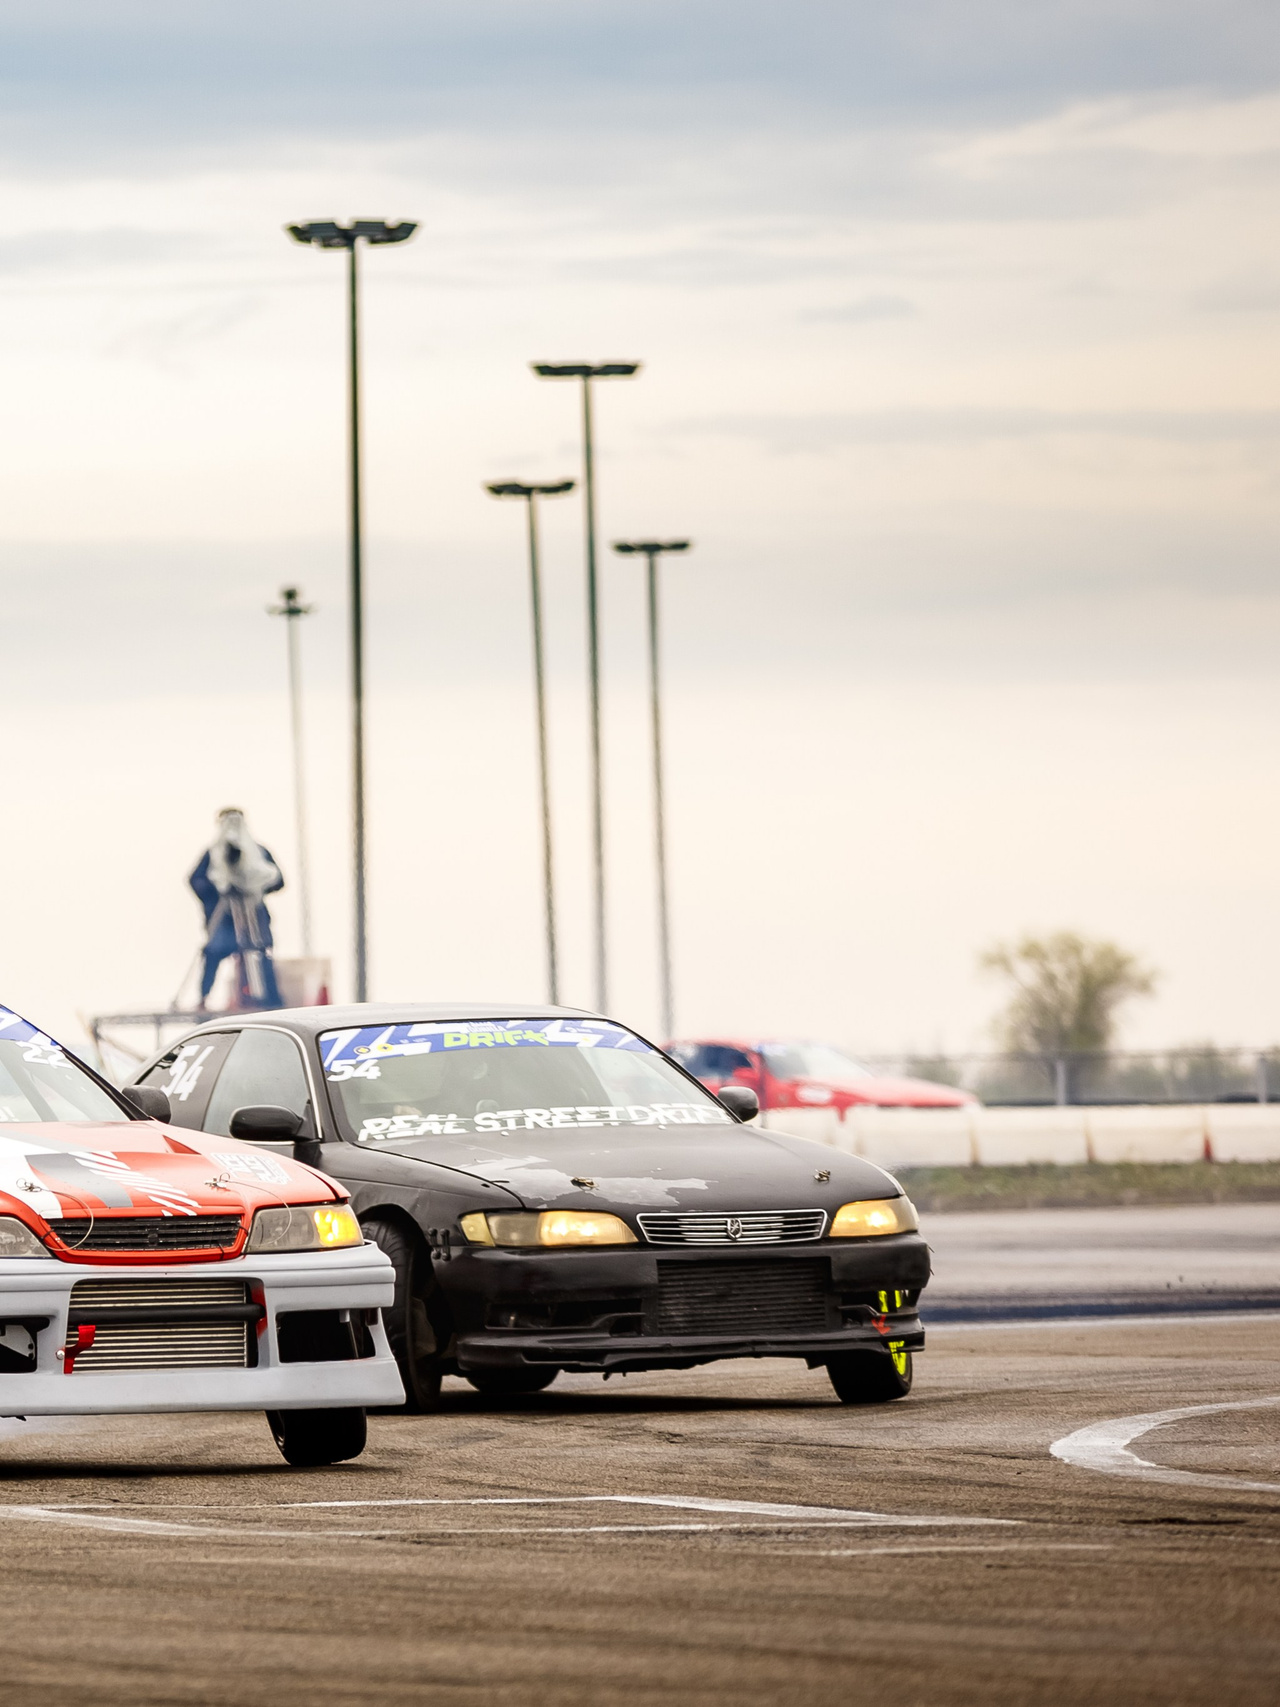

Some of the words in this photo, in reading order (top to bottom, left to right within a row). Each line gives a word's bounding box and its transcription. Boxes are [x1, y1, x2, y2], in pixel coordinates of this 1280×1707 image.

[327, 1059, 382, 1082] 54
[358, 1113, 470, 1142] REAL
[474, 1106, 622, 1133] STREET
